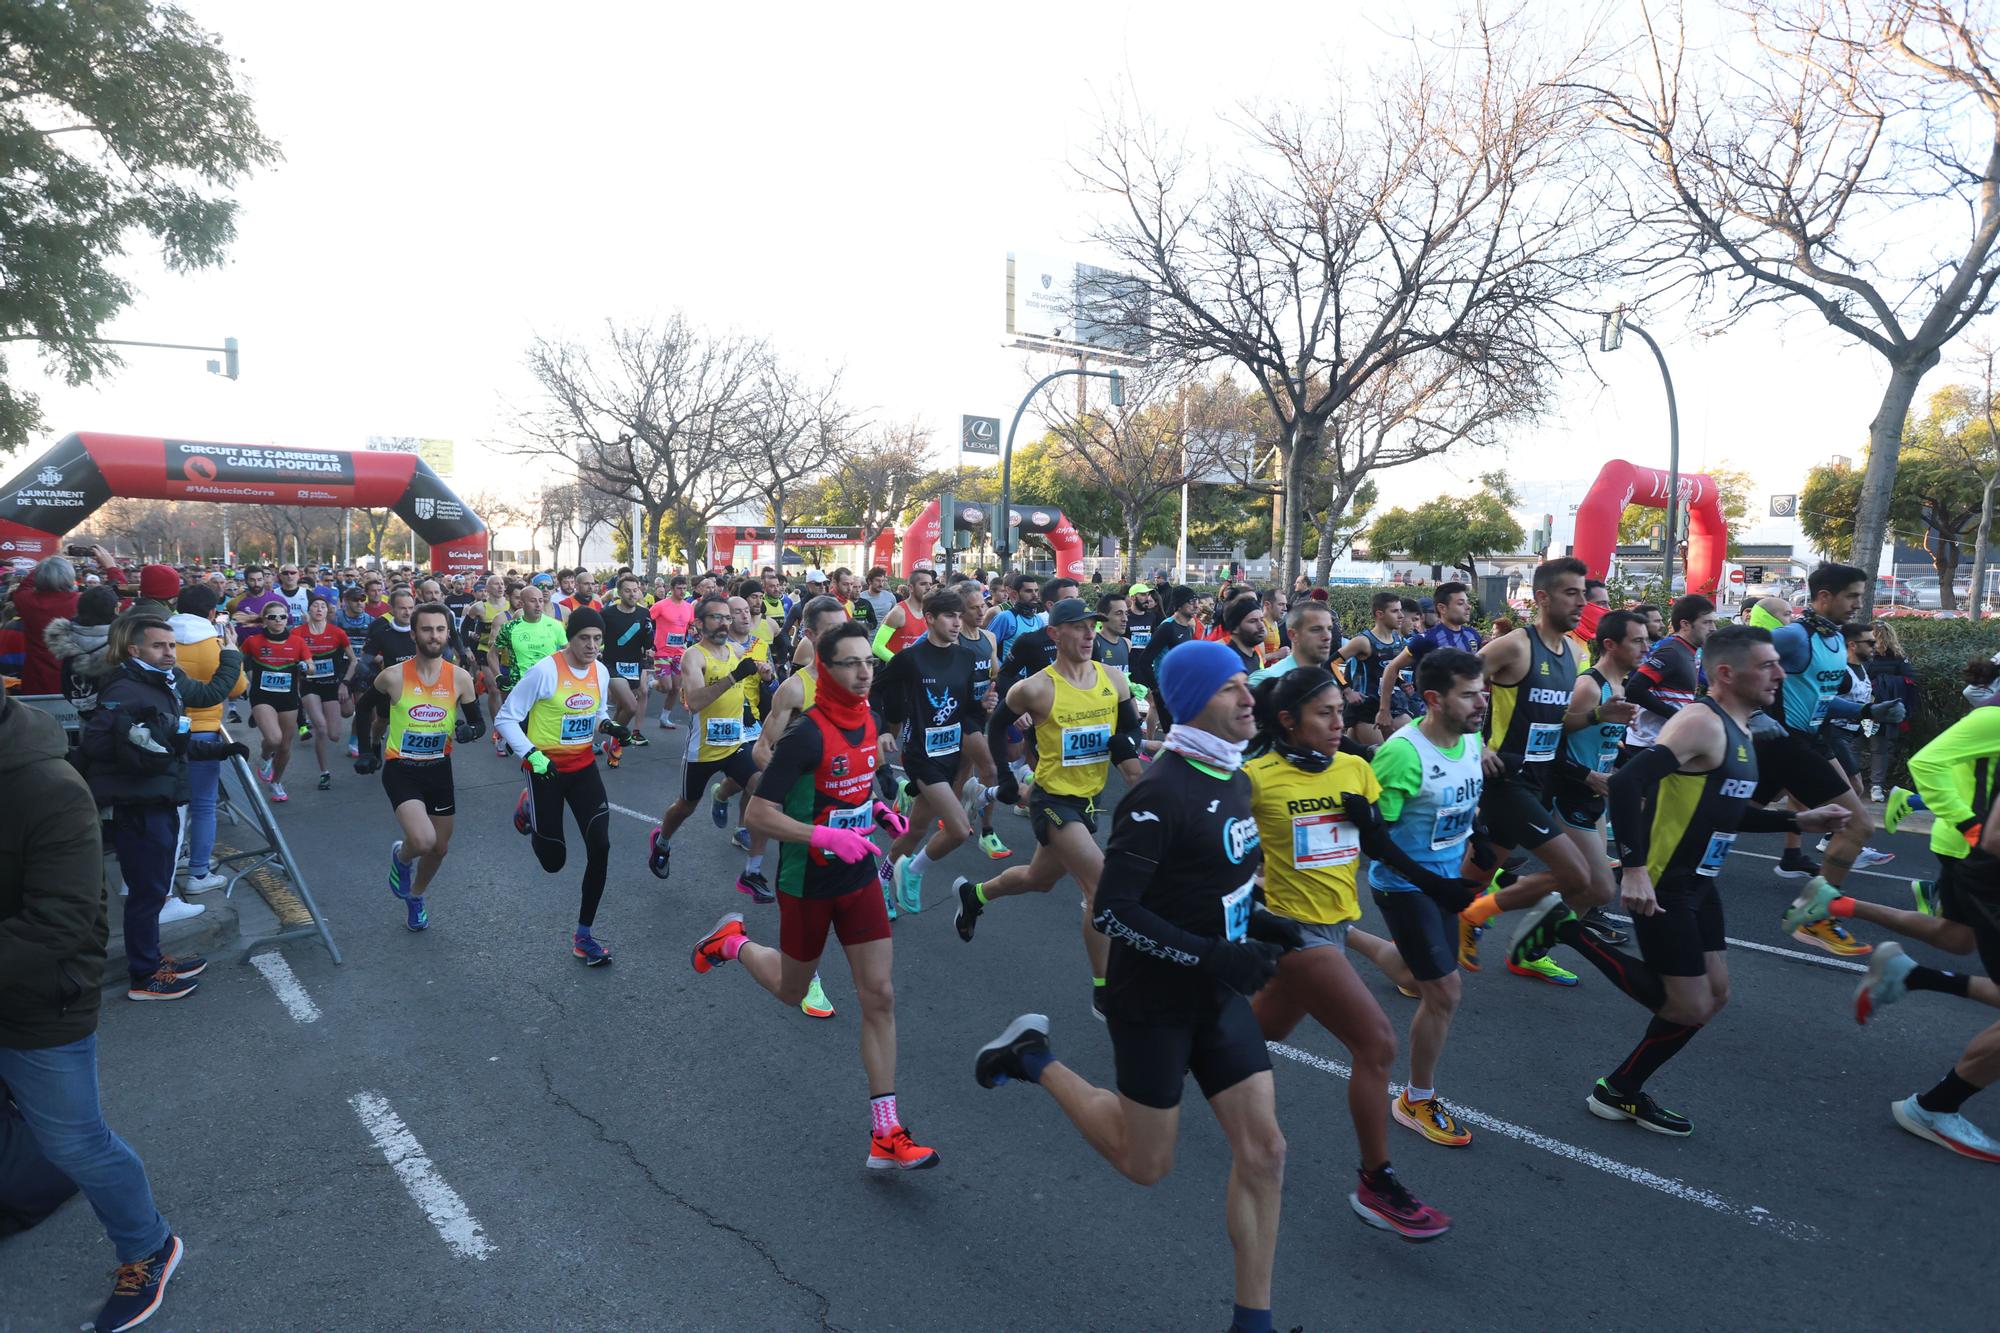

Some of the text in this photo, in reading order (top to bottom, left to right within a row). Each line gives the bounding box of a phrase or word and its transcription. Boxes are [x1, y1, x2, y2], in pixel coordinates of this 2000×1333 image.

[180, 444, 339, 463] CIRCUIT DE CARRERES
[966, 446, 999, 456] LEXUS
[227, 457, 342, 472] CAIXA POPULAR
[17, 490, 85, 499] AJUNTAMENT
[17, 497, 85, 507] DE VALÈNCIA
[412, 708, 444, 718] Serrano
[569, 719, 592, 732] 2291
[931, 729, 955, 745] 2183
[1071, 732, 1102, 750] 2091
[1330, 826, 1338, 843] 1
